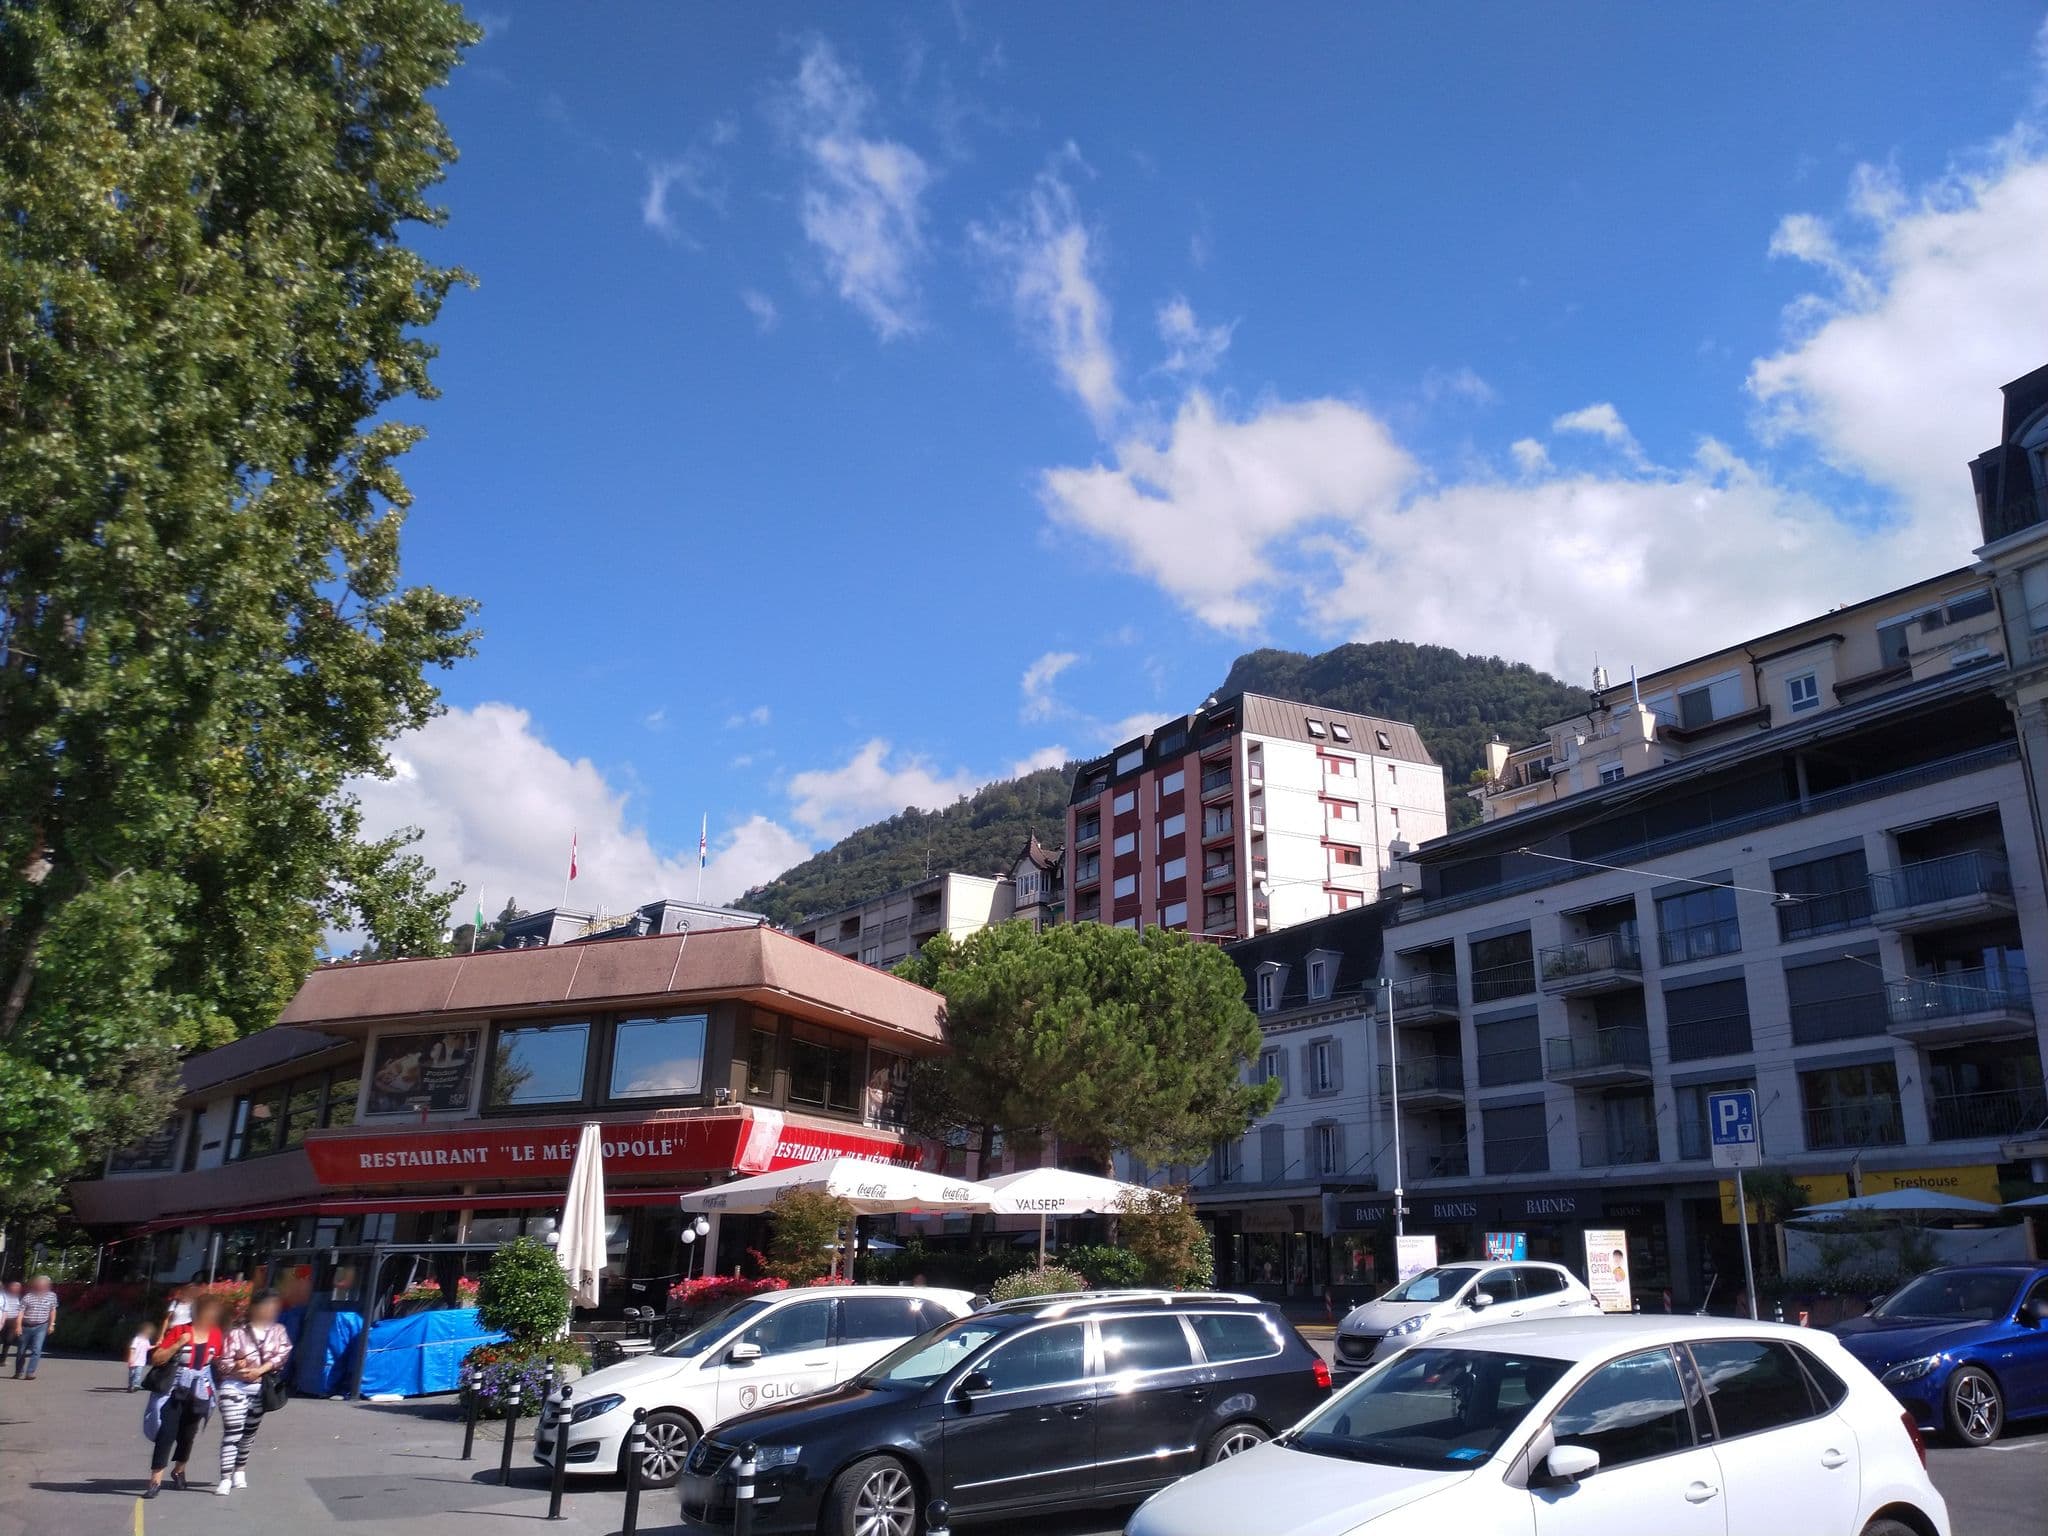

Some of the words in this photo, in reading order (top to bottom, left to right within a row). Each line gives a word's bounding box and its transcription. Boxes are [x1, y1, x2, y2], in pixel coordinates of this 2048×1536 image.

[1719, 1099, 1739, 1136] P
[360, 1147, 488, 1169] RESTAURANT
[1893, 1175, 1960, 1189] Freshouse
[1016, 1198, 1059, 1211] VALSER
[1433, 1202, 1477, 1218] BARNES
[1526, 1198, 1576, 1214] BARNES
